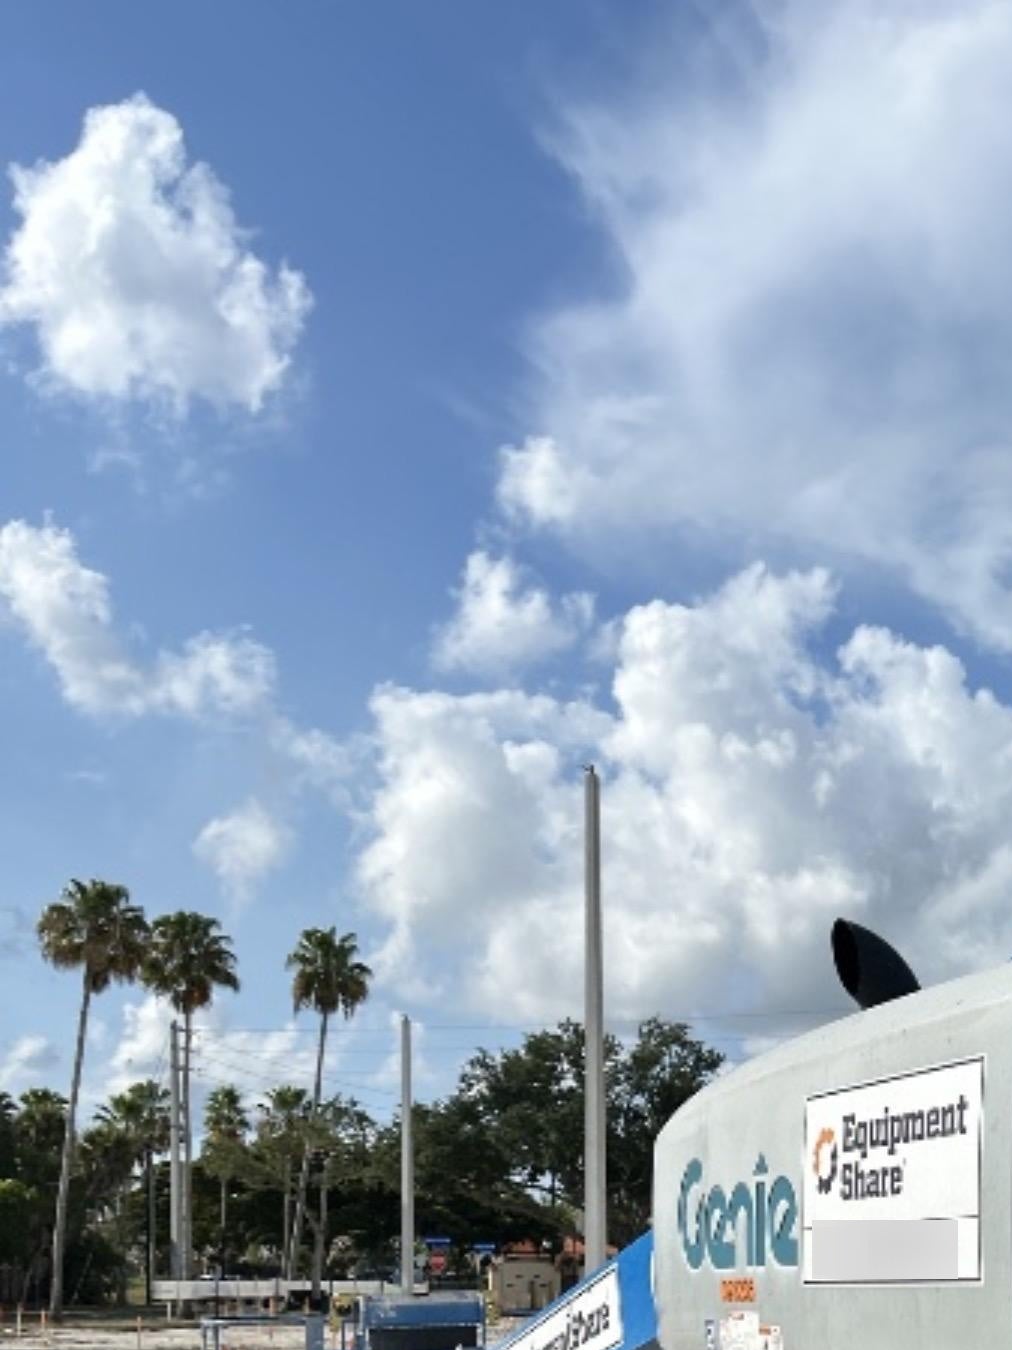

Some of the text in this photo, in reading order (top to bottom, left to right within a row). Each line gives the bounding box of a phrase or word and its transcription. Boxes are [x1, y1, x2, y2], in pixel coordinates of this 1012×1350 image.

[842, 1095, 968, 1158] Equipment
[677, 1152, 798, 1270] Genie
[840, 1163, 902, 1201] Share
